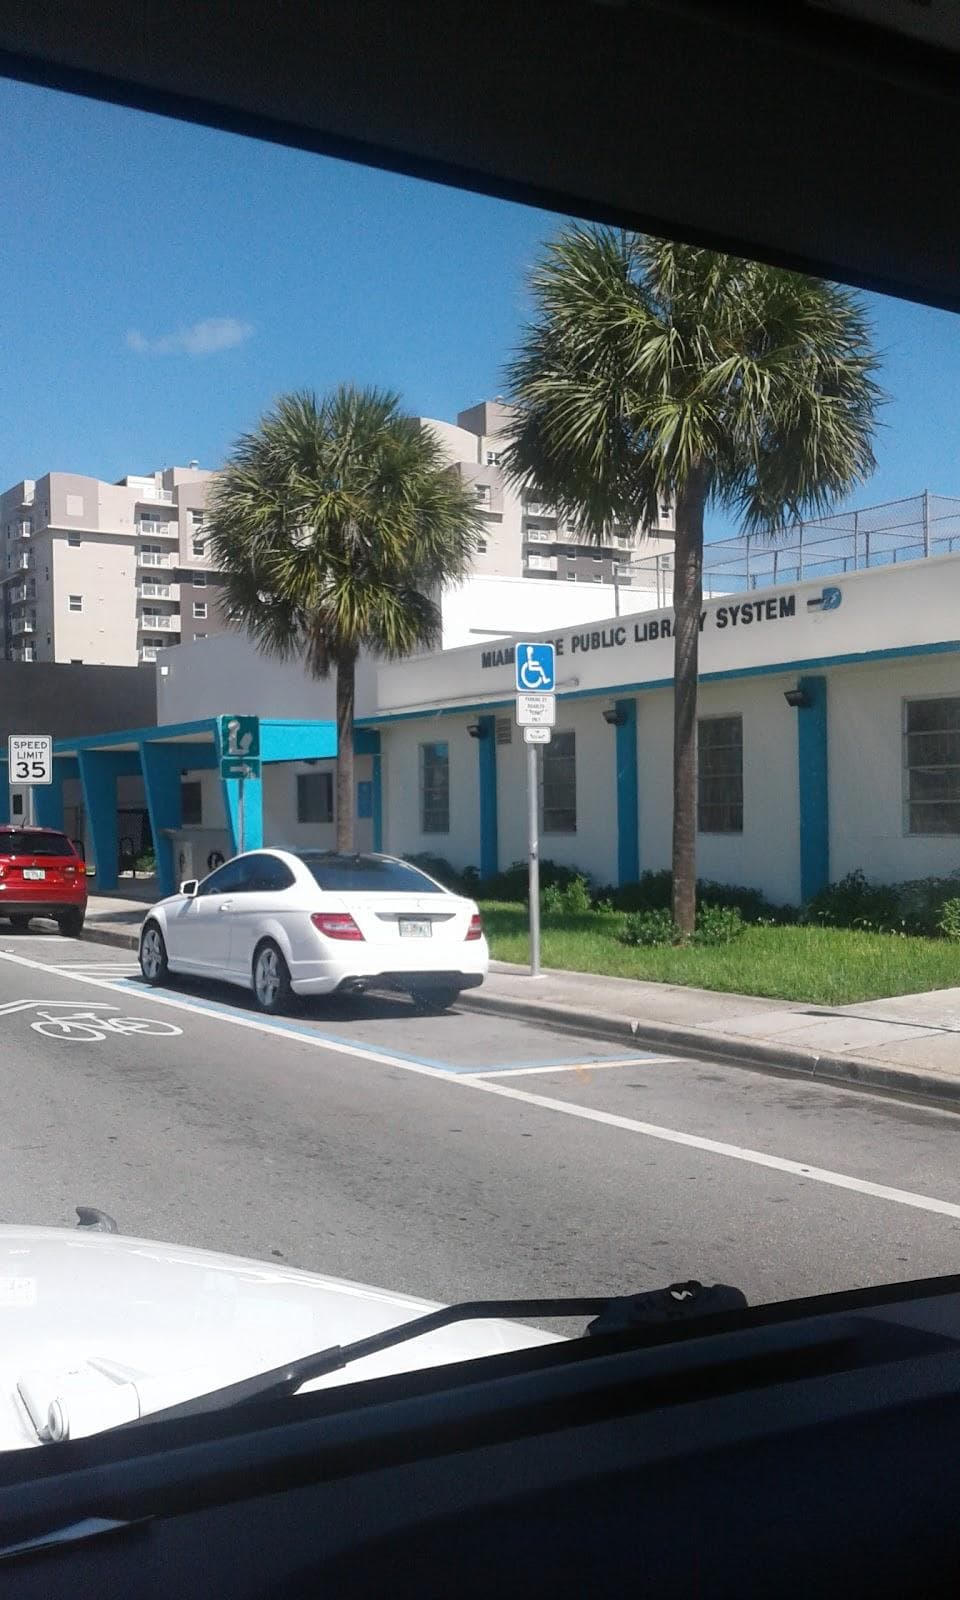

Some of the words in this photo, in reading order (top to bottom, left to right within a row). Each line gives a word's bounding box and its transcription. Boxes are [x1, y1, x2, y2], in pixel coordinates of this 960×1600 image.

[571, 627, 626, 654] PUBLIC
[634, 611, 707, 643] LIBRY
[716, 595, 796, 629] SYSTEM
[13, 741, 48, 750] SPEED
[17, 751, 44, 760] LIMIT
[16, 761, 46, 779] 35
